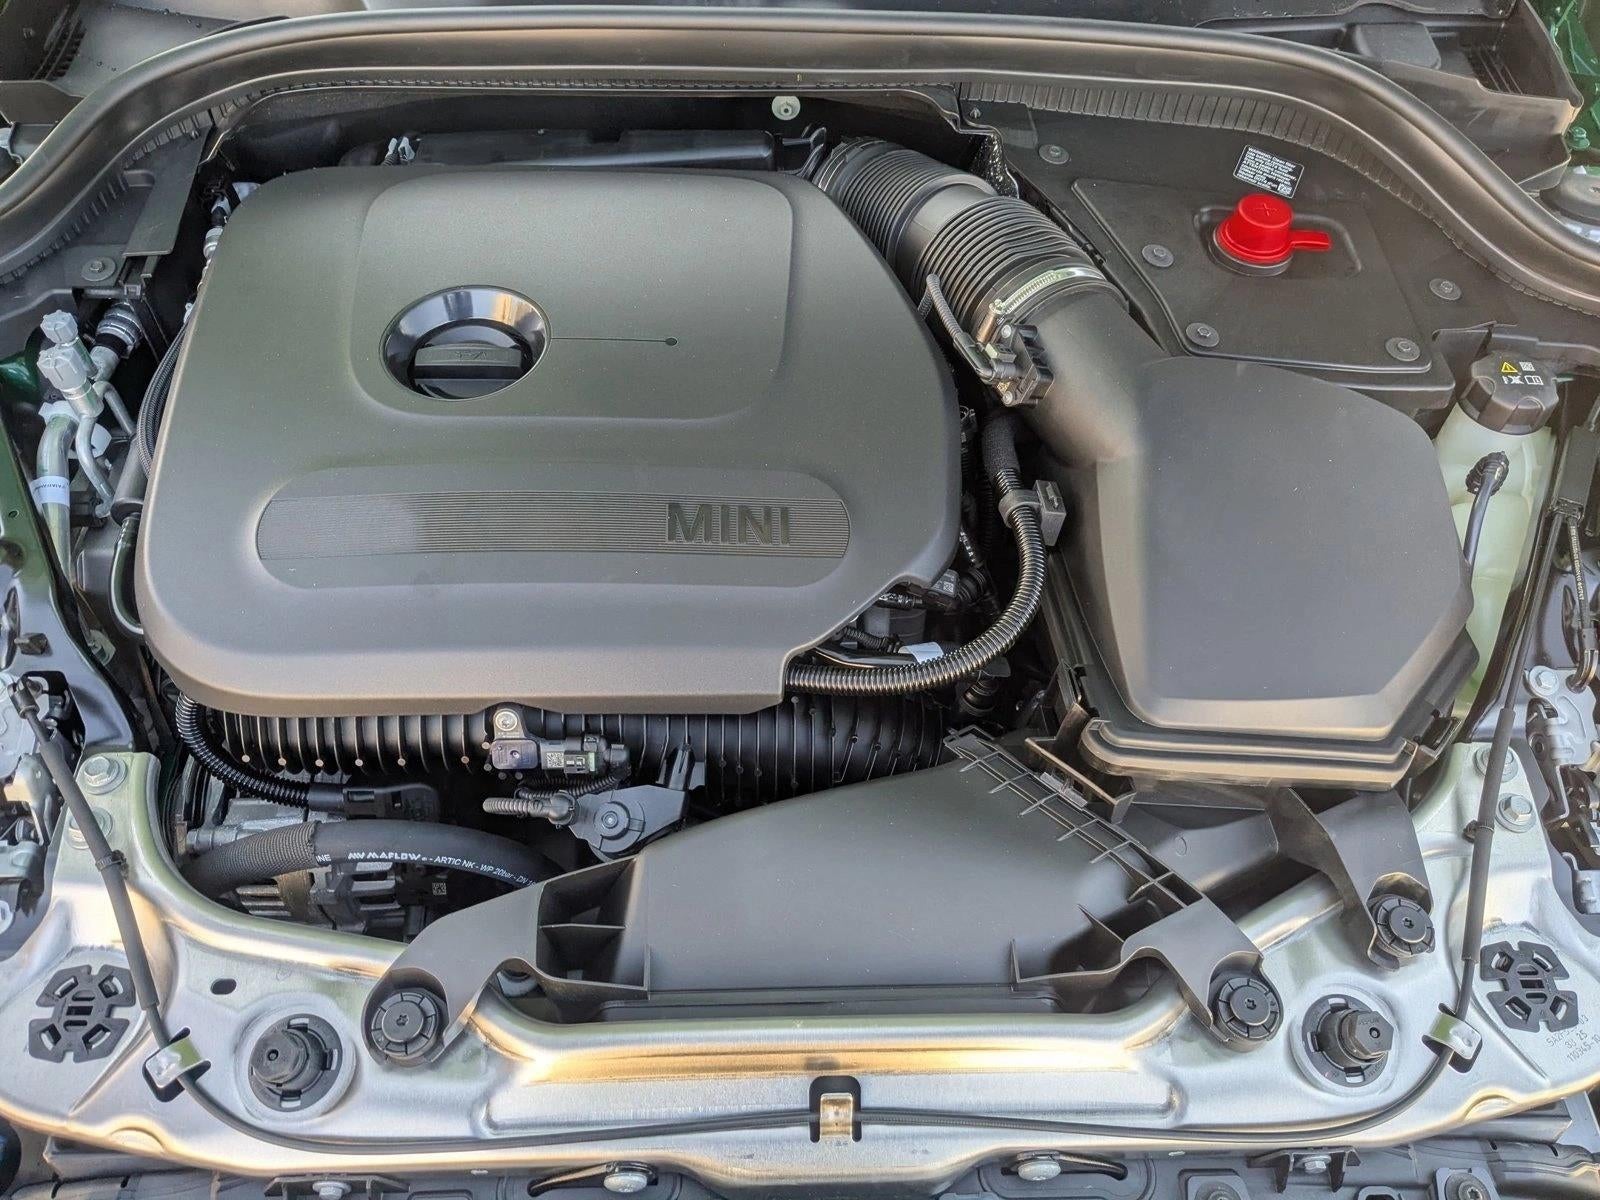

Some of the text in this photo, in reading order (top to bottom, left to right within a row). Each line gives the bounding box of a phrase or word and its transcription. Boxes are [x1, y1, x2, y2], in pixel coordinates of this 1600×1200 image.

[666, 502, 790, 544] MINI
[434, 855, 462, 866] ARTIC
[462, 859, 476, 869] NK
[480, 863, 495, 872] WP
[493, 867, 514, 879] 20bar
